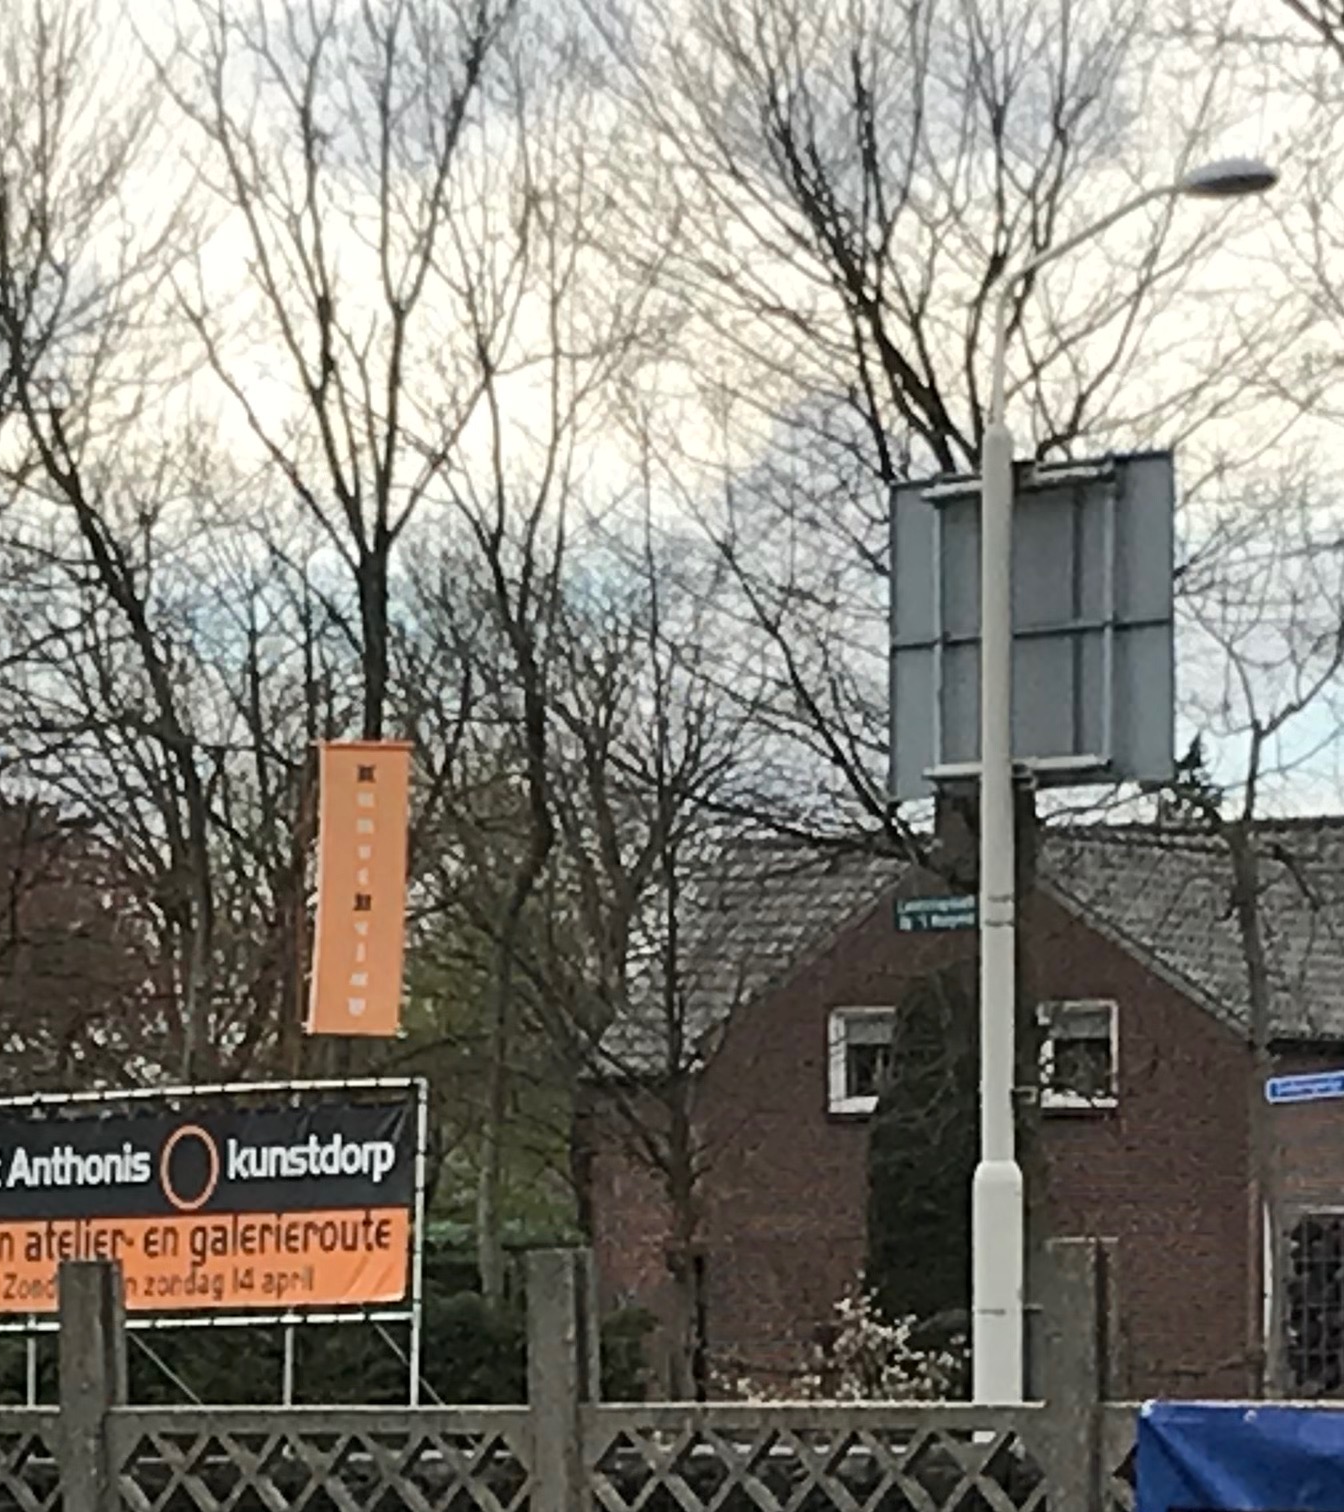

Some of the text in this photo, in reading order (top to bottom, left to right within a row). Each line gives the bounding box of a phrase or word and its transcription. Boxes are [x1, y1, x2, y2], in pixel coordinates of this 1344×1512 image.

[6, 1141, 151, 1188] Anthonis
[227, 1133, 396, 1183] kunstdorp
[143, 1226, 179, 1259] en
[190, 1210, 392, 1267] galerieroute
[3, 1272, 58, 1300] Zond
[143, 1264, 225, 1300] zondag
[232, 1265, 255, 1292] 14
[261, 1264, 314, 1298] april
